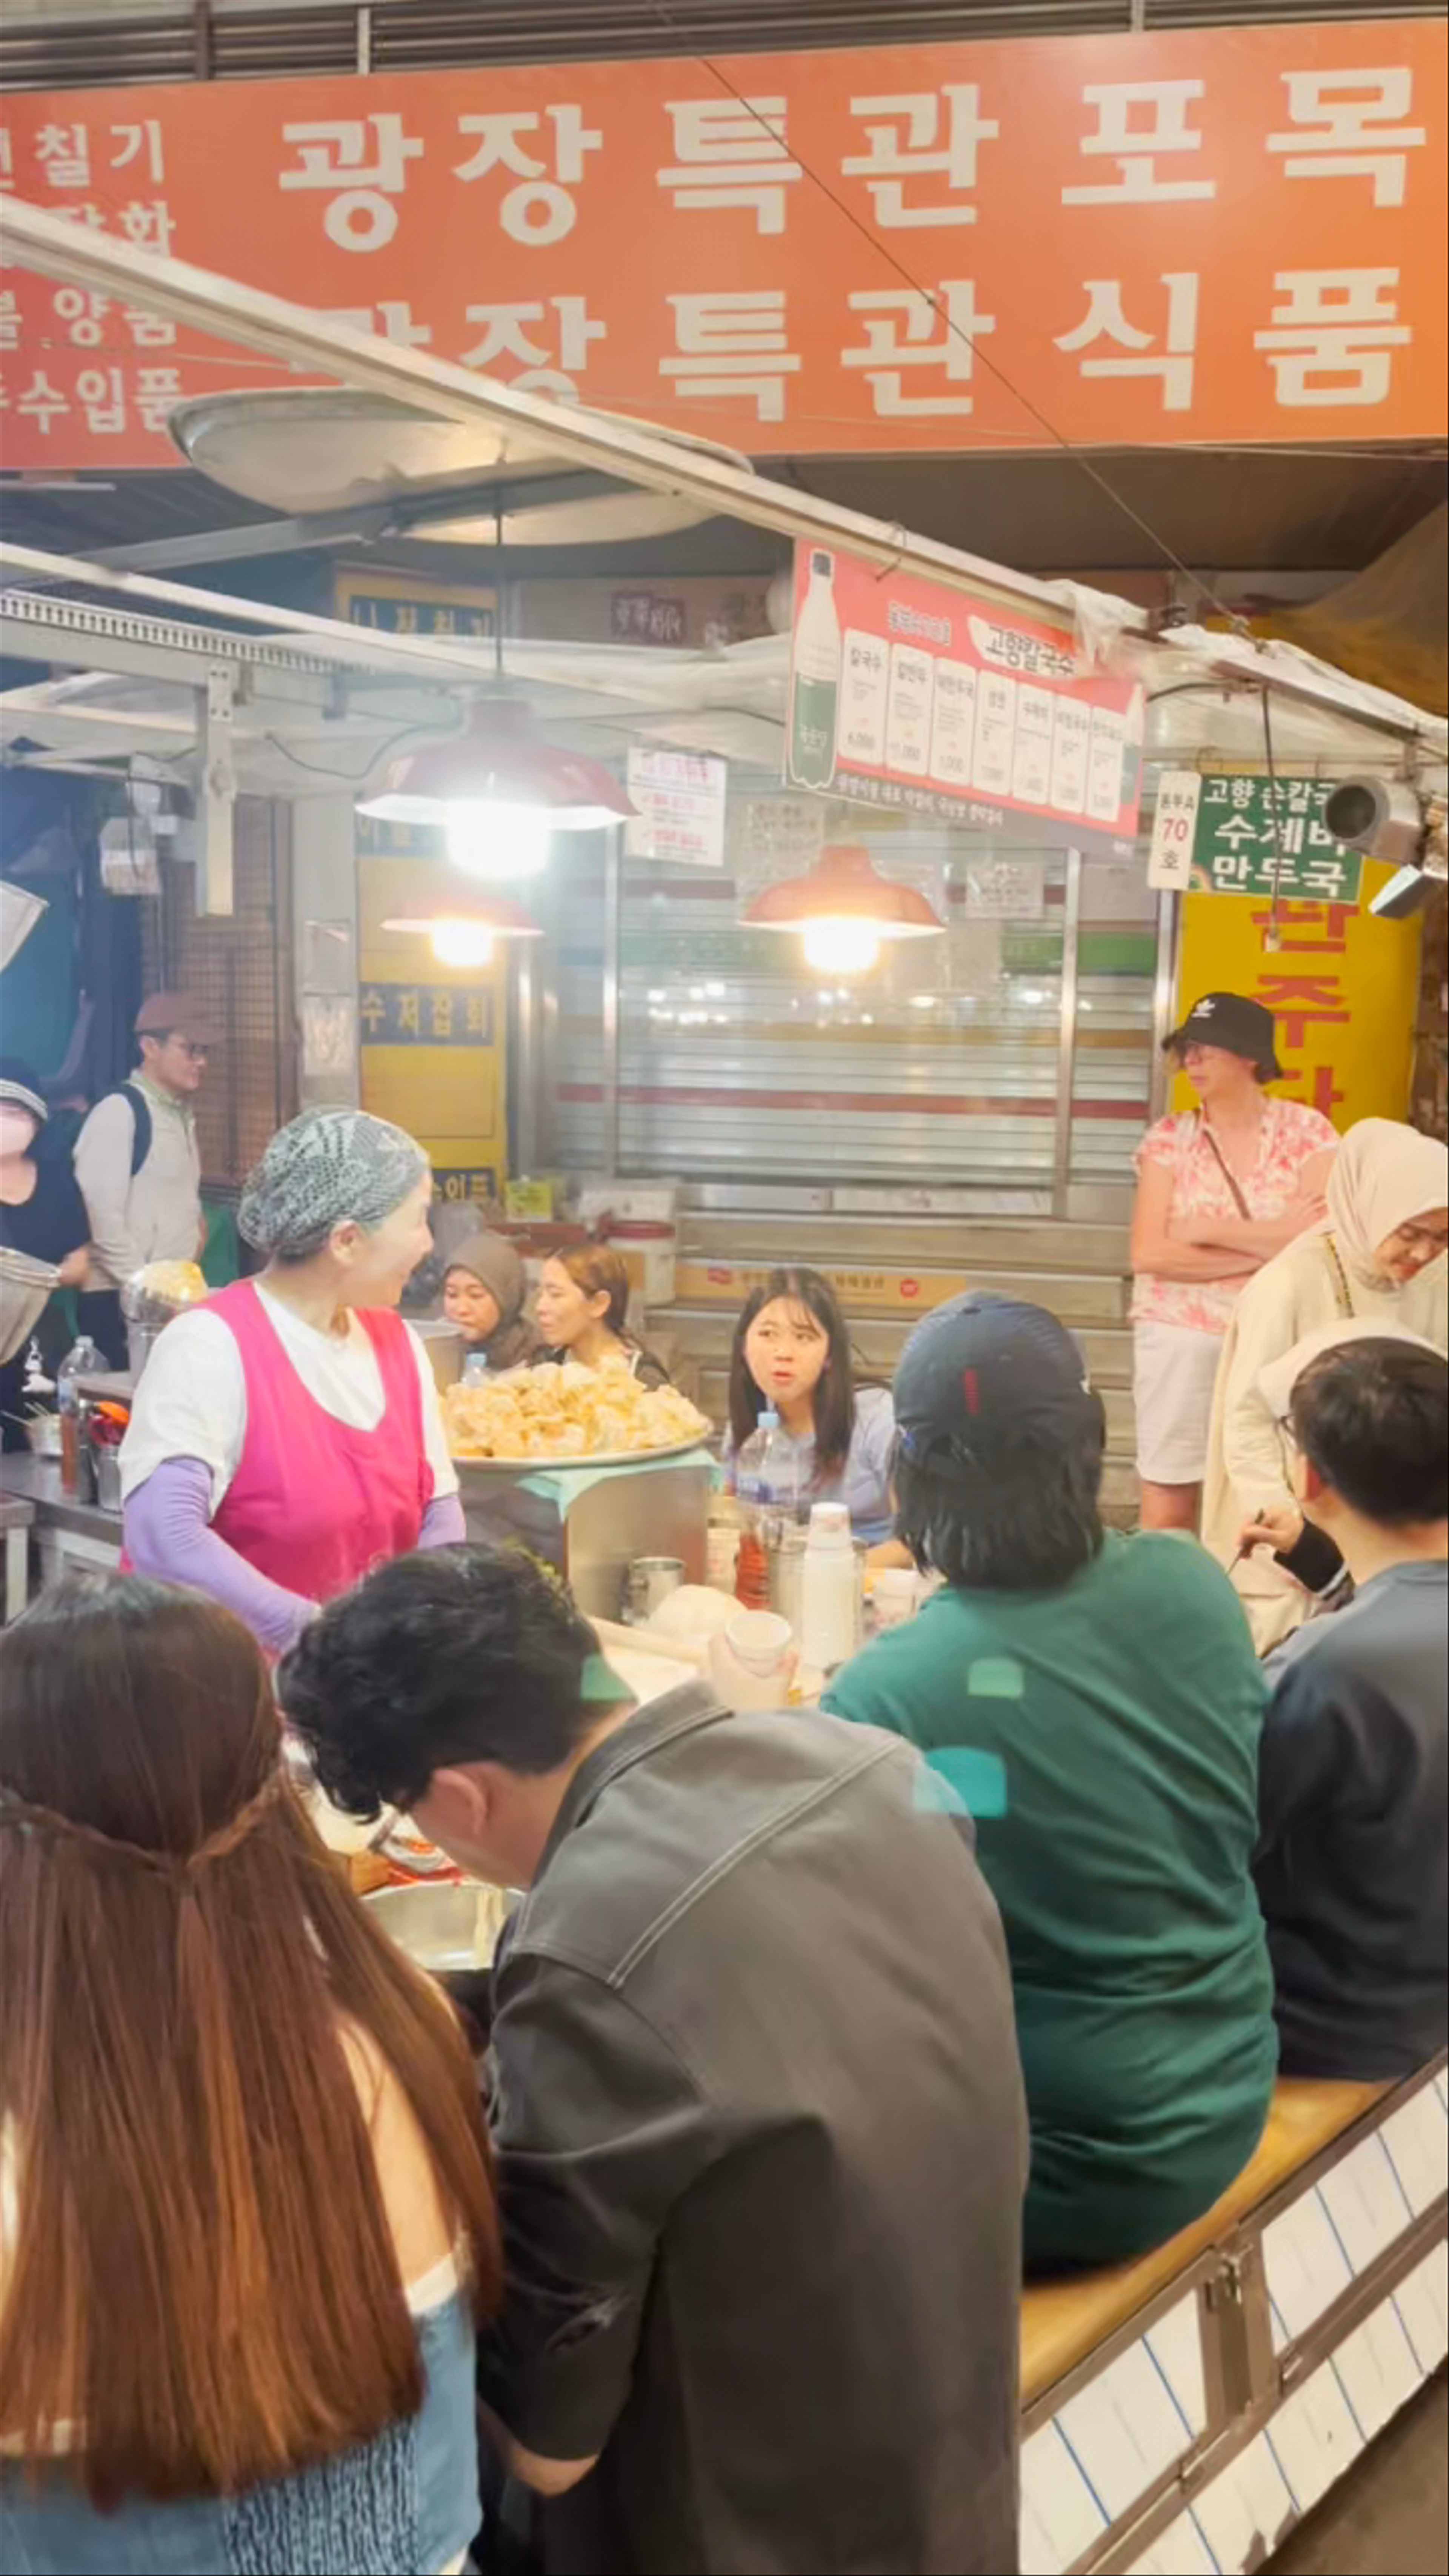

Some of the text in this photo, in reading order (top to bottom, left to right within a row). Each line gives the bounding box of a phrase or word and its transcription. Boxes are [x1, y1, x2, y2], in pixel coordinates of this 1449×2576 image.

[1061, 67, 1427, 207] 포목
[1052, 267, 1412, 411] 식품
[0, 368, 182, 433] 수입품
[1204, 779, 1255, 809] 고향
[1163, 817, 1188, 841] 70
[1159, 849, 1180, 870] 호
[1213, 855, 1347, 898] 만두국
